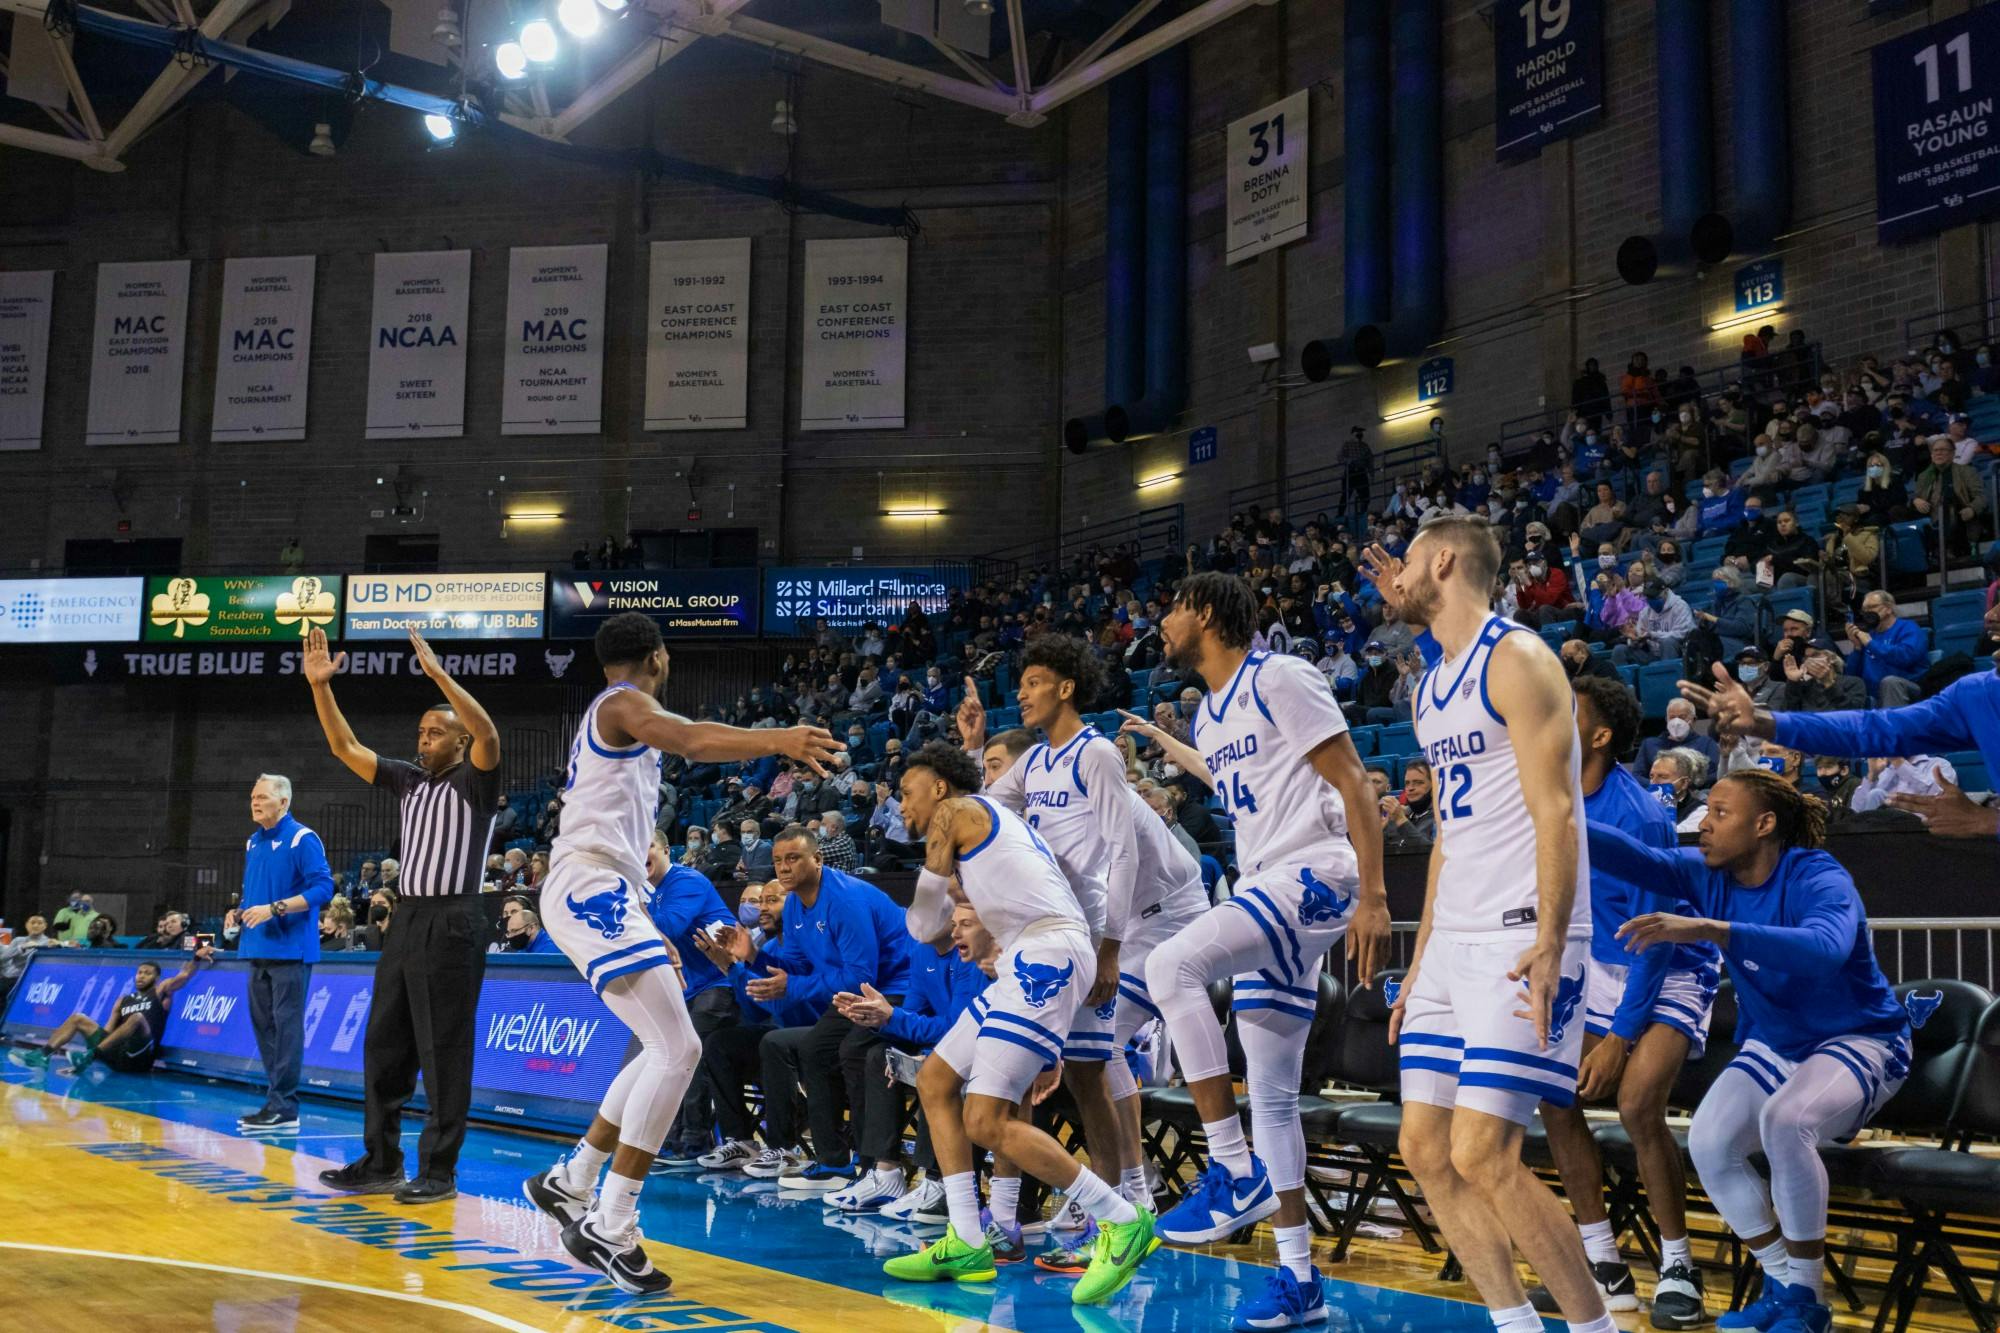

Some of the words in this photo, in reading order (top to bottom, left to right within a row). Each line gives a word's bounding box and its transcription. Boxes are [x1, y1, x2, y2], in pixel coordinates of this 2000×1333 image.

[1519, 0, 1571, 48] 19
[1516, 41, 1576, 79] HAROLD
[1913, 31, 1973, 104] 11
[1526, 61, 1567, 91] KUHN
[1534, 78, 1585, 105] BASKETBALL
[1907, 98, 1994, 141] RASAUN
[1247, 112, 1285, 167] 31
[1913, 120, 1989, 157] YOUNG
[1243, 164, 1290, 193] BRENNA
[1898, 167, 1931, 184] MEN'S
[1251, 181, 1281, 204] DOTY
[538, 265, 578, 274] WOMEN'S
[403, 278, 440, 286] WOMEN'S
[532, 274, 583, 283] BASKETBALL
[673, 276, 726, 287] 1991-1992
[827, 275, 884, 286] 1993-1994
[118, 289, 167, 298] BASKETBALL
[244, 284, 292, 293] BASKETBALL
[395, 287, 446, 295] BASKETBALL
[1744, 282, 1774, 305] 113
[544, 307, 569, 317] 2019
[664, 304, 693, 315] EAST
[696, 303, 735, 314] COAST
[820, 304, 849, 314] EAST
[852, 302, 892, 313] COAST
[407, 313, 433, 323] 2018
[661, 316, 737, 328] CONFERENCE
[816, 316, 896, 327] CONFERENCE
[114, 316, 166, 335] MAC
[522, 318, 588, 342] MAC
[233, 328, 295, 351] MAC
[378, 325, 457, 348] NCAA
[665, 330, 733, 341] CHAMPIONS
[821, 329, 890, 340] CHAMPIONS
[108, 346, 169, 357] CHAMPIONS
[522, 343, 587, 354] CHAMPIONS
[1, 355, 26, 363] WNIT
[232, 352, 294, 363] CHAMPIONS
[539, 368, 567, 376] NCAA
[676, 370, 718, 379] WOMEN'S
[833, 370, 876, 379] WOMEN'S
[400, 379, 433, 388] SWEET
[520, 377, 587, 388] TOURNAMENT
[669, 379, 724, 388] BASKETBALL
[825, 378, 882, 388] BASKETBALL
[1425, 376, 1448, 396] 112
[247, 384, 274, 394] NCAA
[228, 394, 293, 405] TOURNAMENT
[396, 390, 436, 400] SIXTEEN
[527, 394, 554, 402] ROUND
[556, 394, 566, 402] OF
[1195, 443, 1211, 460] 111
[435, 581, 544, 593] ORTHOPAEDICS
[610, 580, 658, 592] VISION
[818, 579, 874, 597] Millard
[878, 578, 946, 596] Fillmore
[353, 583, 389, 603] UB
[395, 584, 432, 603] MD
[445, 594, 486, 602] SPORTS
[489, 593, 543, 602] MEDICINE
[50, 596, 137, 608] EMERGENCY
[608, 597, 683, 609] FINANCIAL
[687, 595, 739, 607] GROUP
[816, 600, 896, 617] Suburban
[50, 613, 124, 624] MEDICINE
[218, 611, 264, 620] Reuben
[350, 618, 381, 630] Team
[383, 617, 427, 630] Doctors
[430, 616, 447, 629] for
[483, 614, 504, 629] UB
[506, 612, 538, 629] Bulls
[675, 618, 722, 627] MassMutual
[722, 618, 739, 626] firm
[210, 626, 271, 636] Sandwich
[124, 653, 192, 675] TRUE
[198, 652, 264, 675] BLUE
[1205, 733, 1258, 777] BUFFALO
[259, 1203, 521, 1260] PUBLIC
